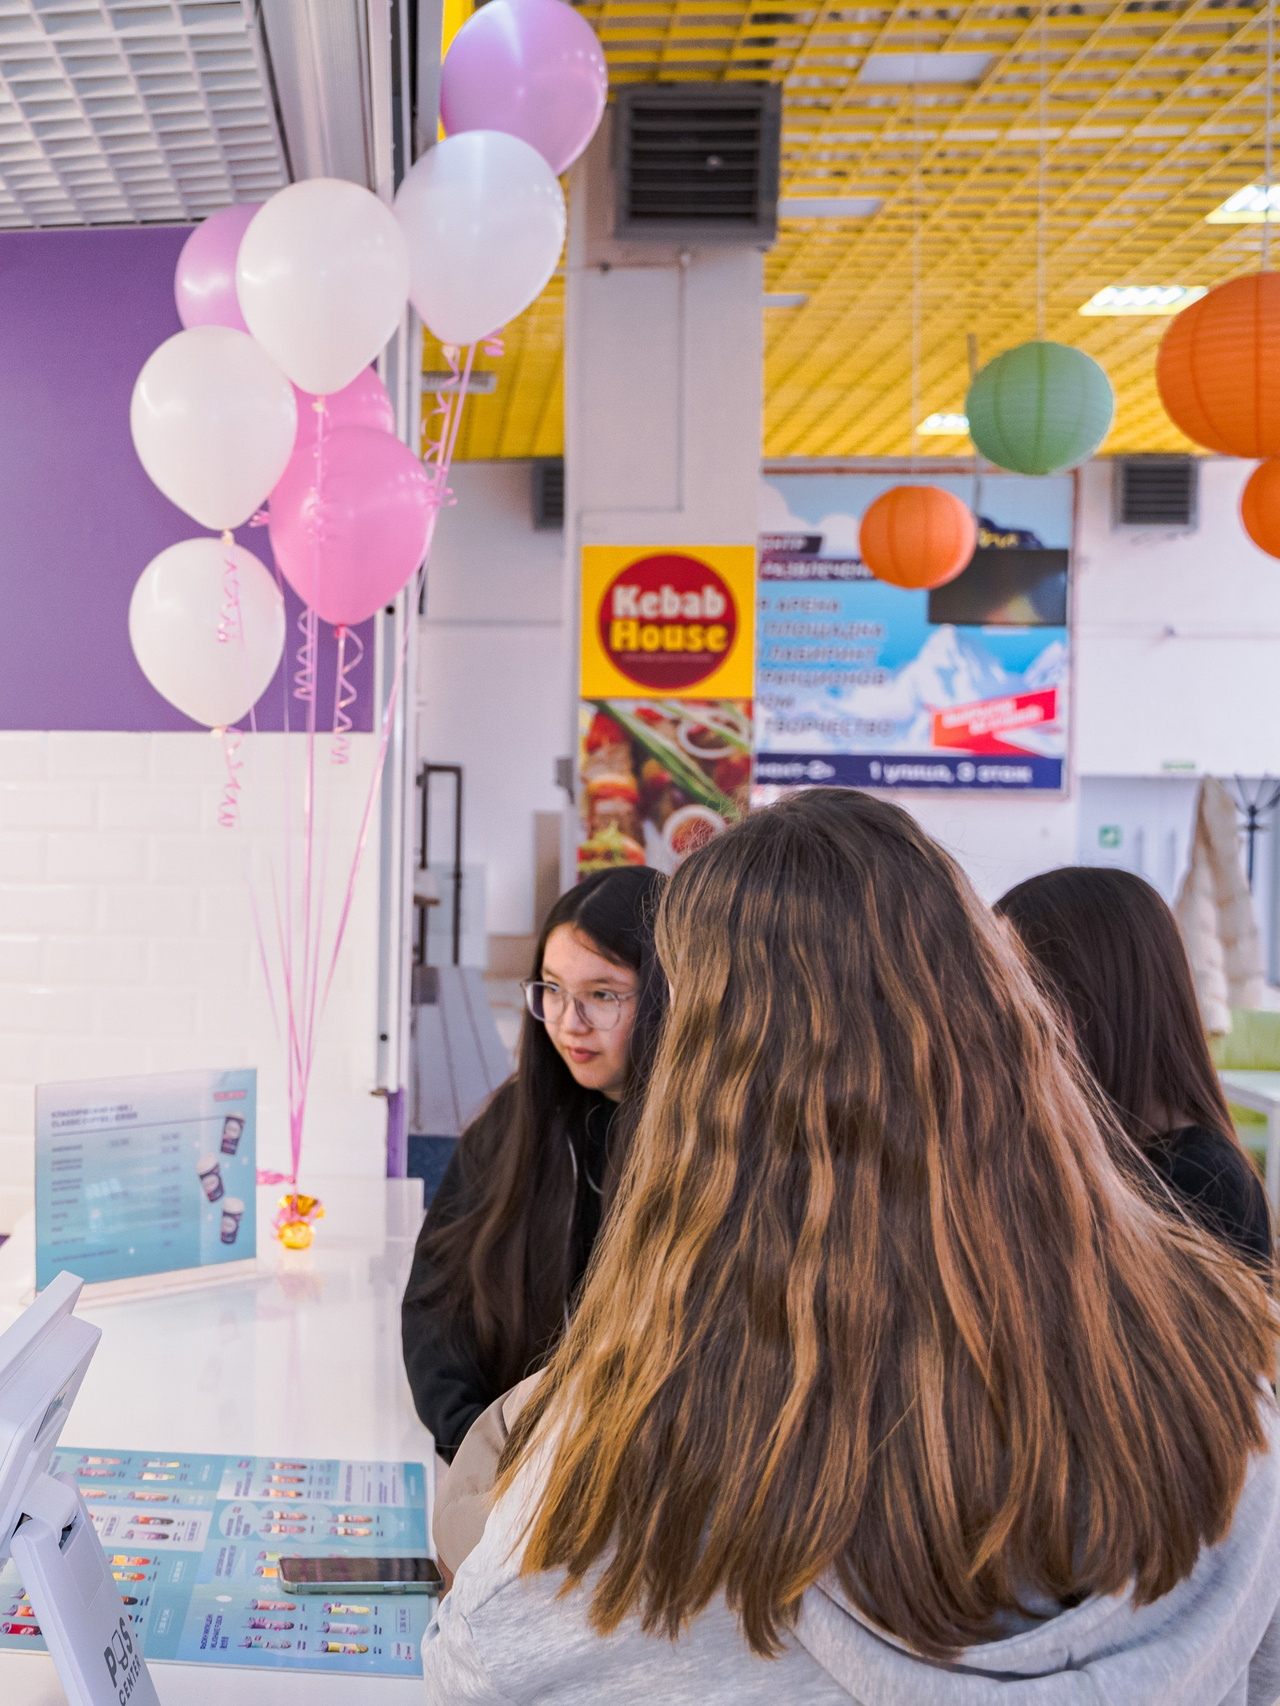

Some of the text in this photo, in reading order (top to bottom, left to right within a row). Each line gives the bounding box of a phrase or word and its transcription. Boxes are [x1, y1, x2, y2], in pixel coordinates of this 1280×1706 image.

[612, 584, 726, 619] Kebab
[610, 618, 728, 652] House
[869, 760, 882, 781] 1
[956, 761, 976, 782] 3
[118, 1654, 142, 1706] CENTER
